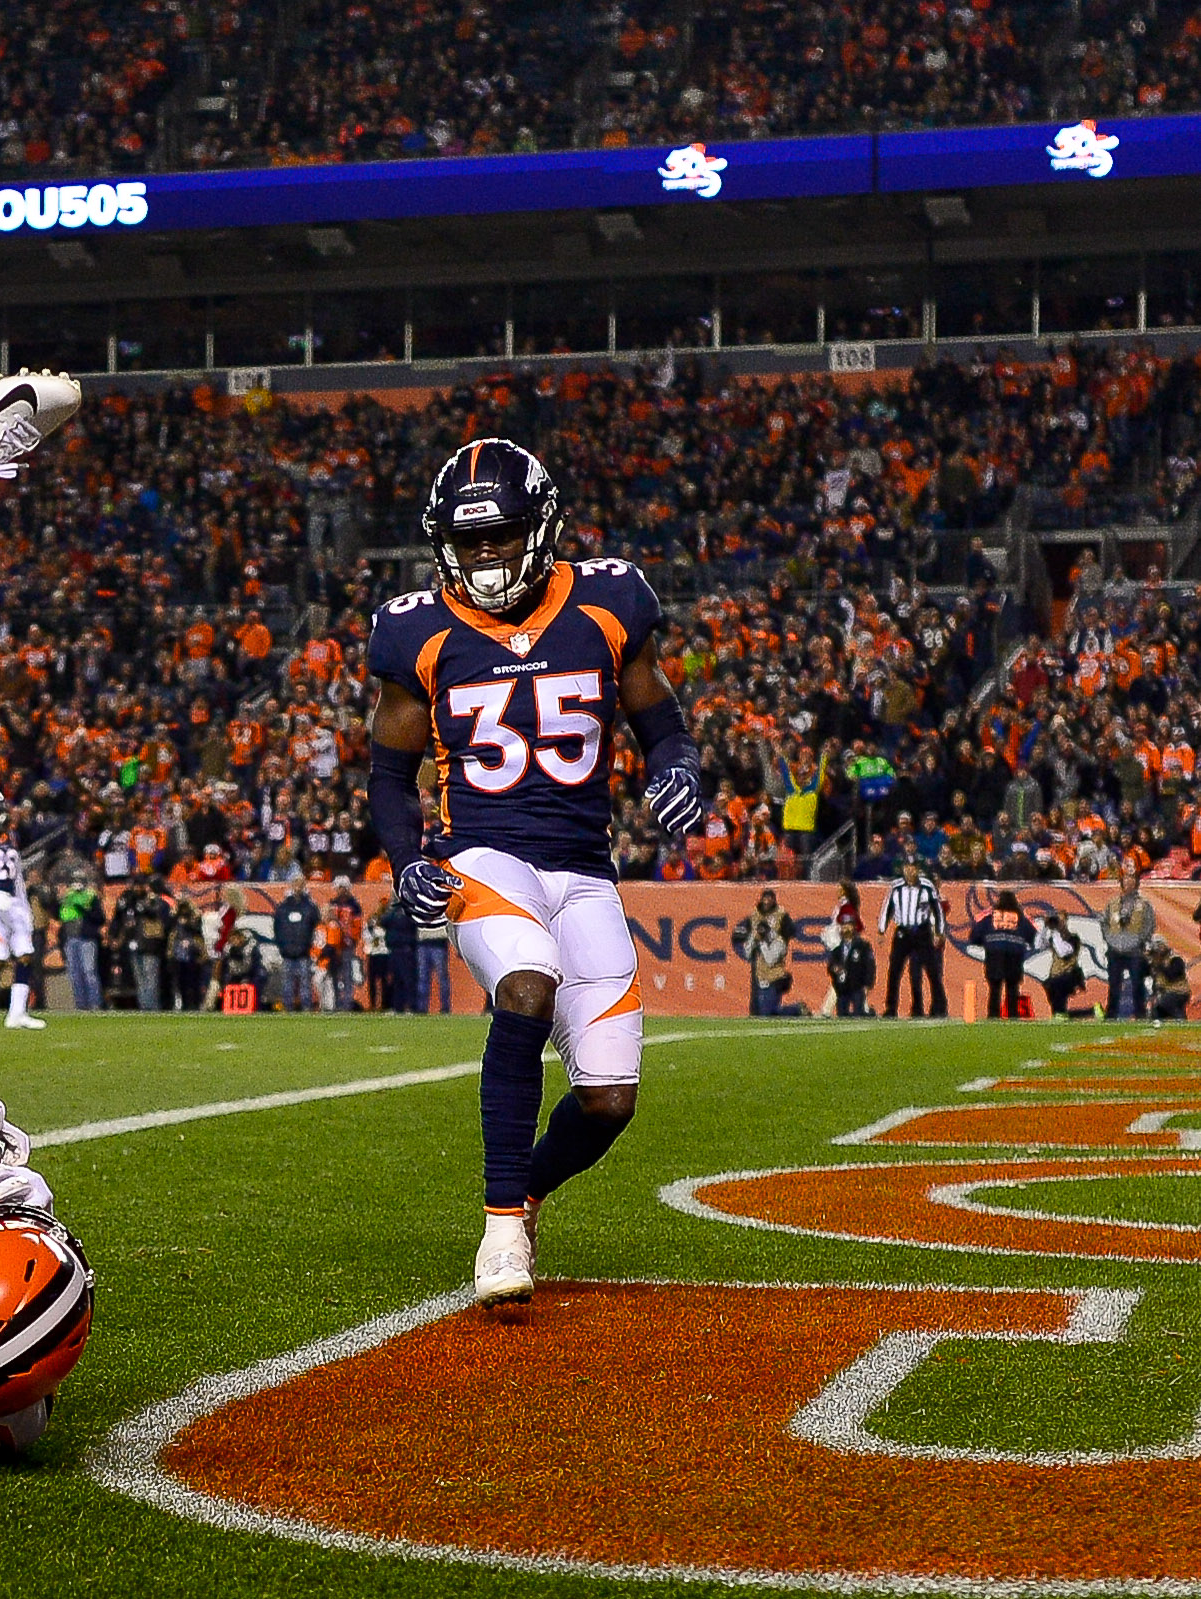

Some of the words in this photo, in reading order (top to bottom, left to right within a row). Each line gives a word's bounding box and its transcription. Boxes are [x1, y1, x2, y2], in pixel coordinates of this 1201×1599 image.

[492, 661, 548, 675] BRONCOS
[448, 669, 603, 793] 35
[229, 988, 249, 1009] 10
